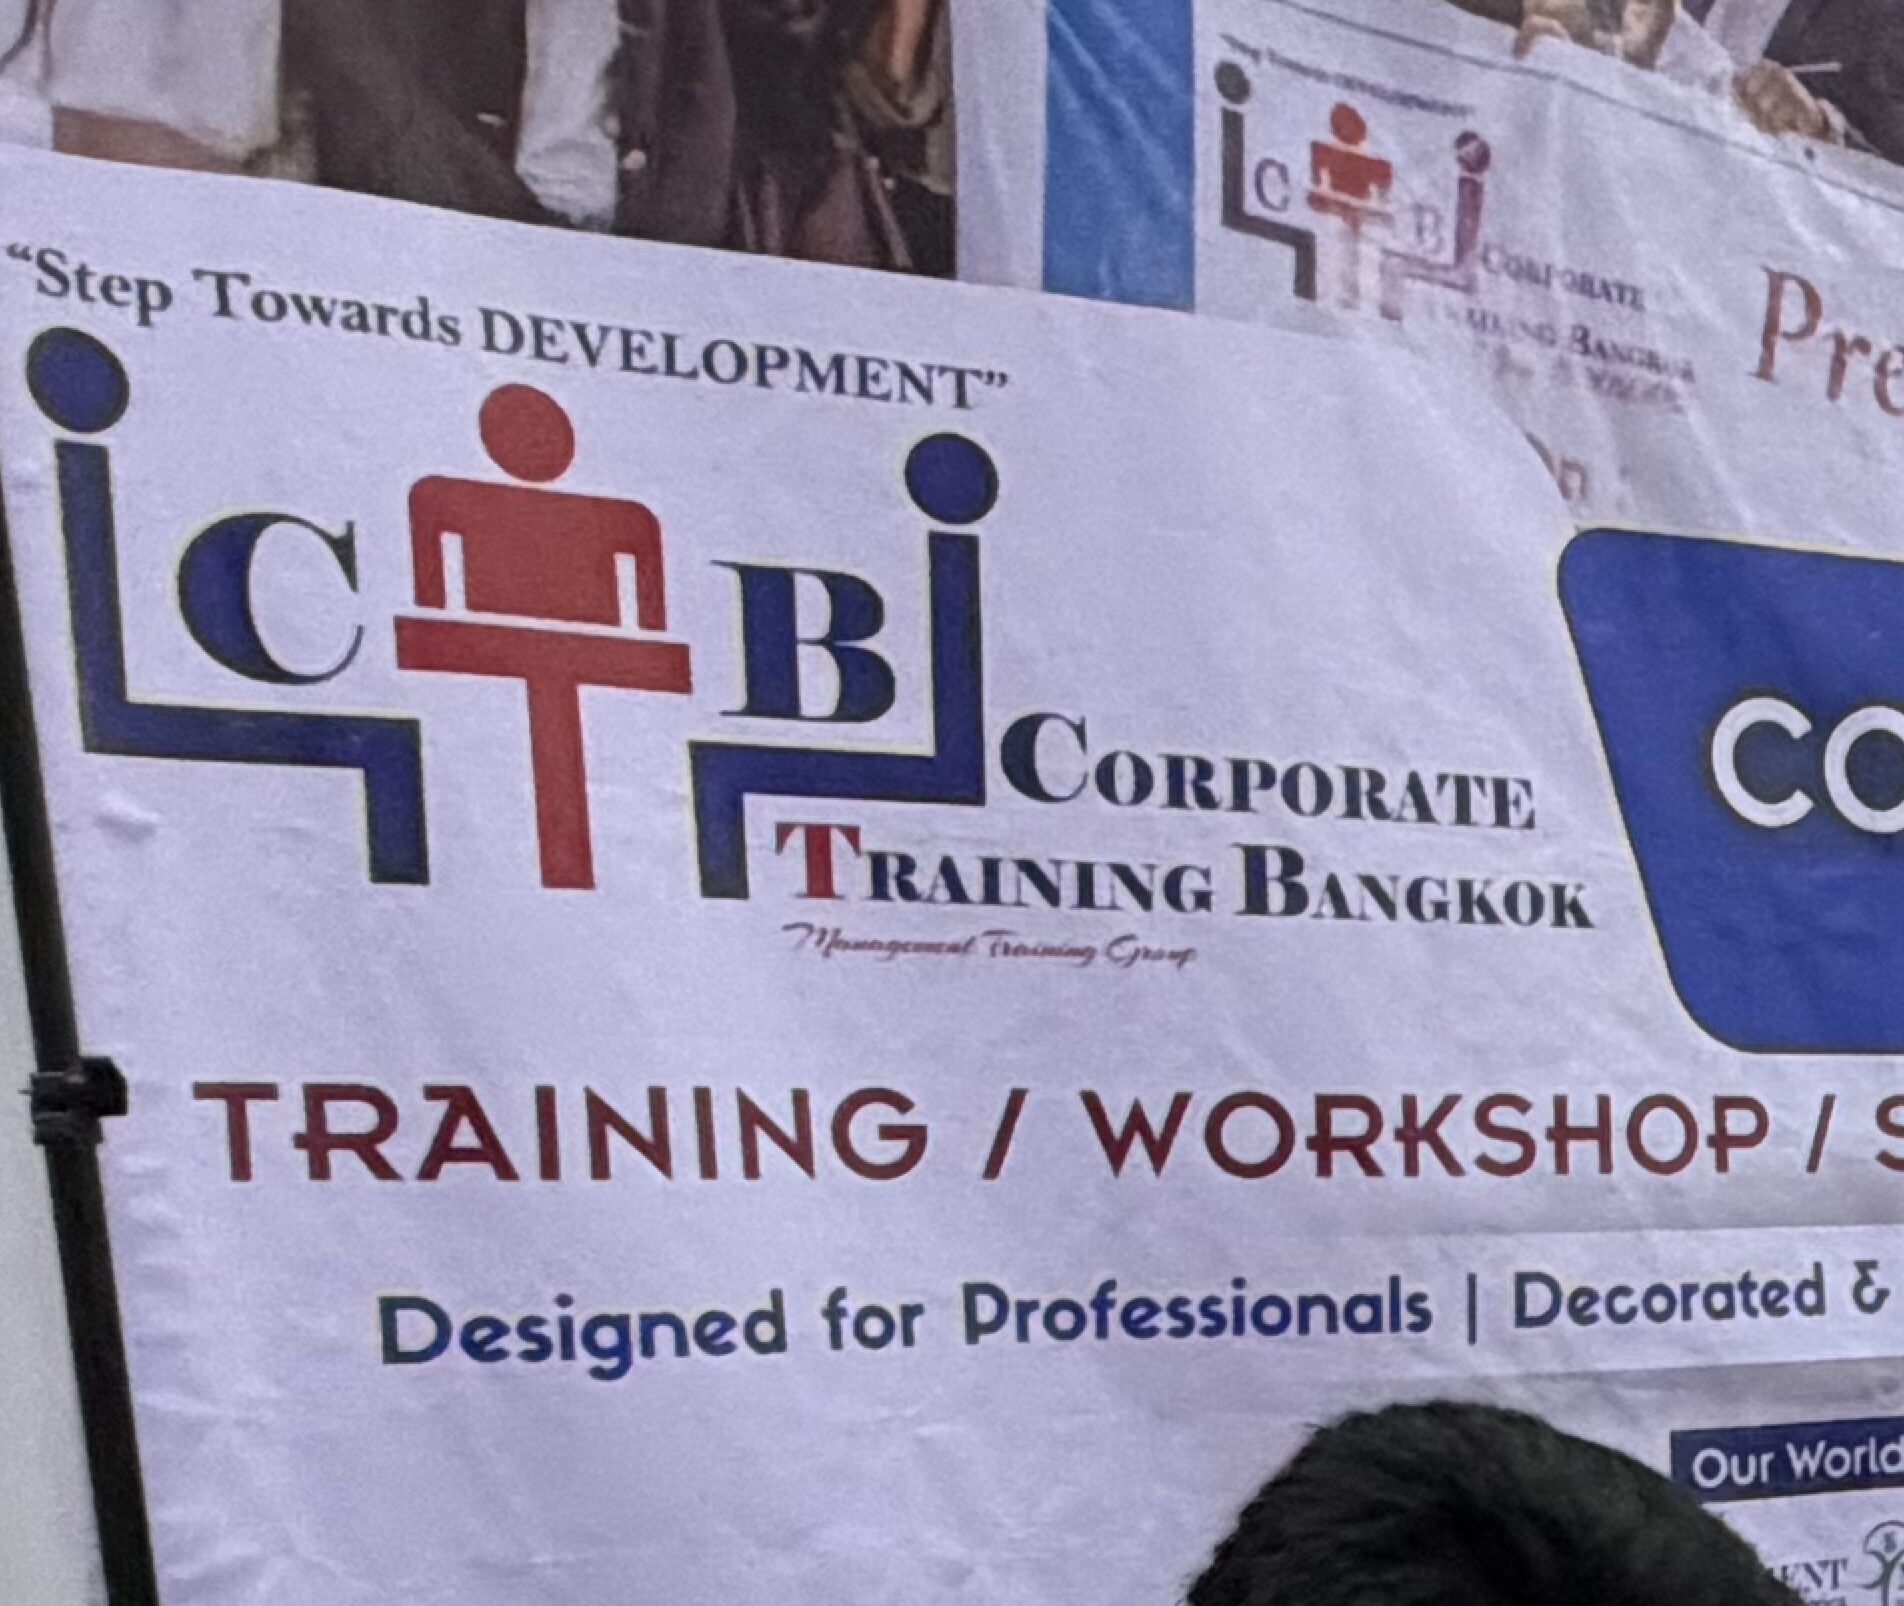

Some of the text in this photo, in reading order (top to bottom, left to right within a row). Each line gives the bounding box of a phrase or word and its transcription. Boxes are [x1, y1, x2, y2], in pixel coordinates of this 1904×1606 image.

[192, 268, 462, 346] Towards
[1000, 712, 1536, 831] CORPORATE
[775, 822, 1595, 930] TRAINING BANGKOK
[983, 929, 1096, 968] Training
[193, 1081, 928, 1182] TRAINING
[982, 1088, 1028, 1179] /
[1080, 1090, 1769, 1179] WORKSHOP
[1806, 1094, 1836, 1173] /
[377, 1288, 788, 1381] Designed
[822, 1286, 925, 1351] for
[962, 1274, 1433, 1345] Professionals
[1513, 1261, 1826, 1330] Decorated
[1851, 1259, 1890, 1315] &
[1692, 1448, 1775, 1489] Our
